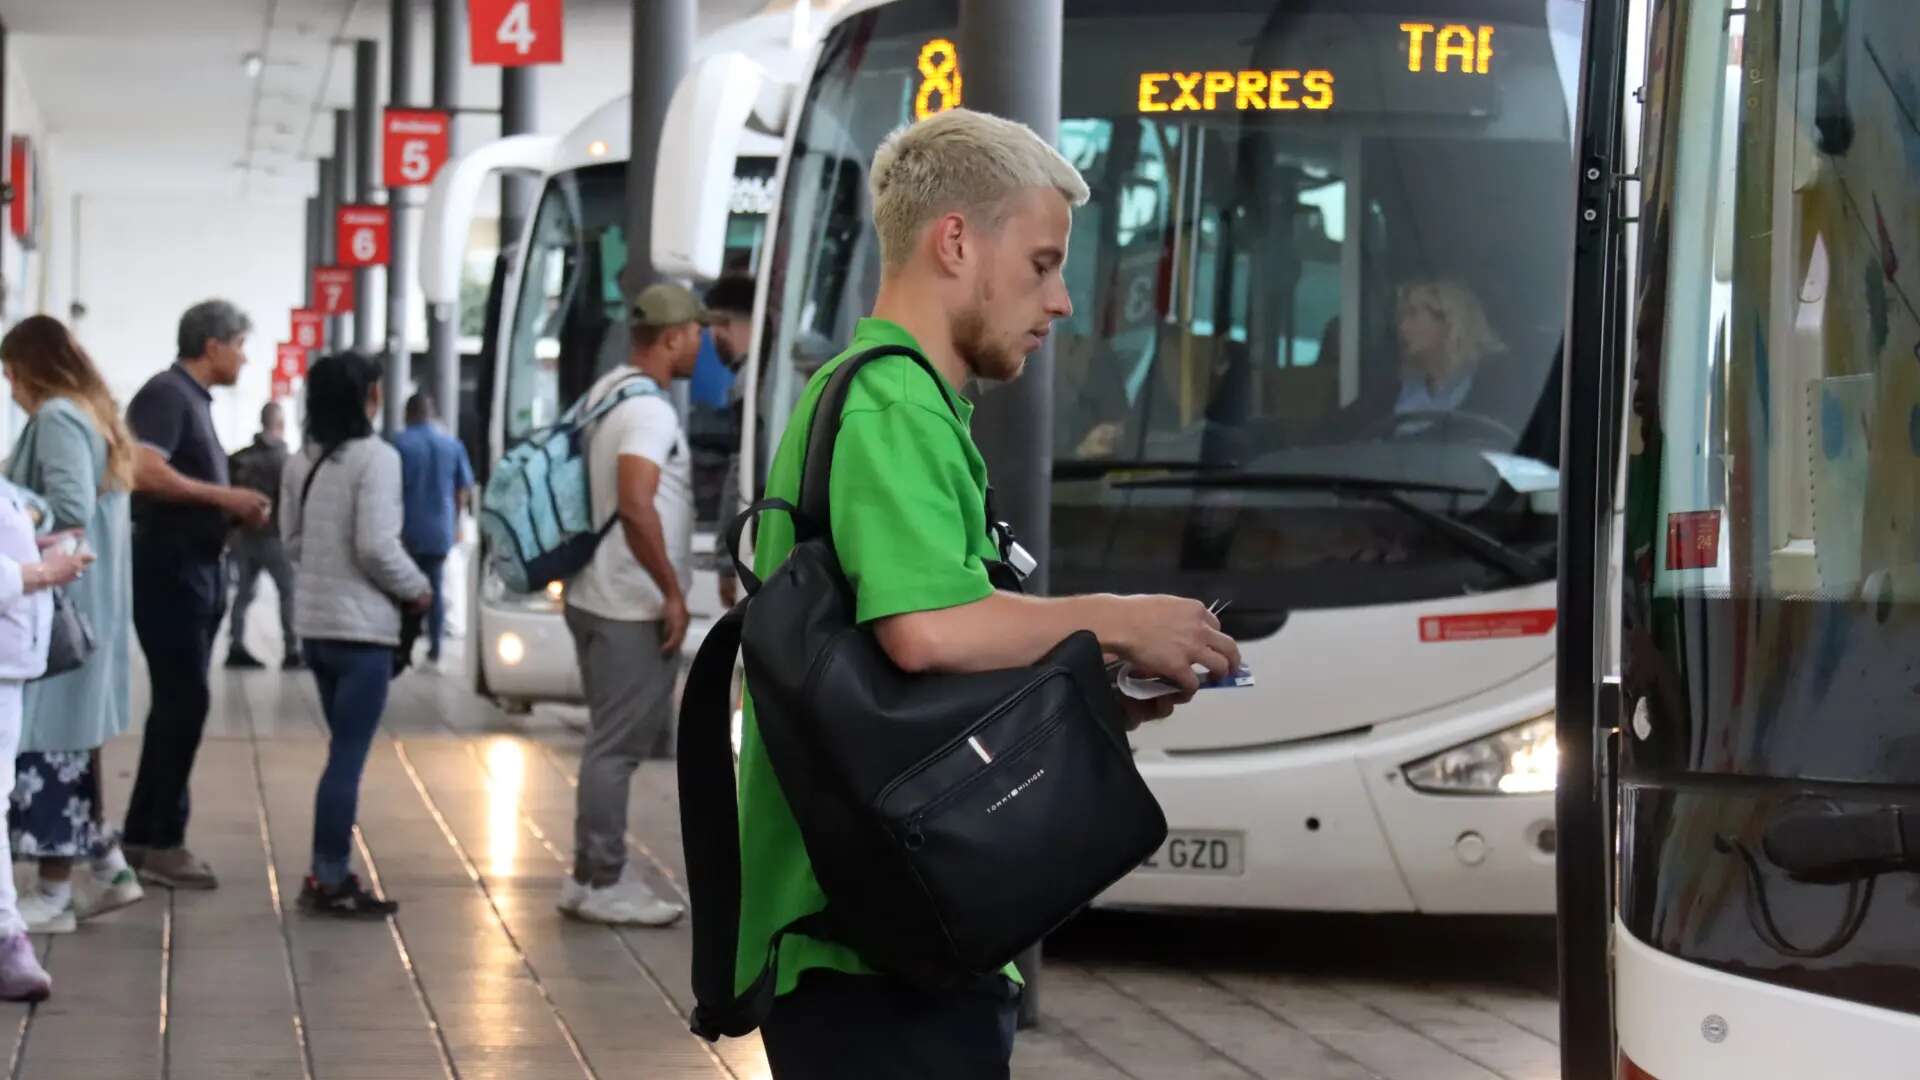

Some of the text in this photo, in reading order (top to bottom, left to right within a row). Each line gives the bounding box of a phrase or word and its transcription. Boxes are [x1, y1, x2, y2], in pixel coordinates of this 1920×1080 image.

[496, 1, 537, 54] 4
[1138, 70, 1334, 112] EXPRES
[401, 140, 430, 180] 5
[352, 229, 376, 260] 6
[322, 284, 342, 311] 7
[986, 794, 1012, 813] TOMMY
[1168, 838, 1229, 870] GZD
